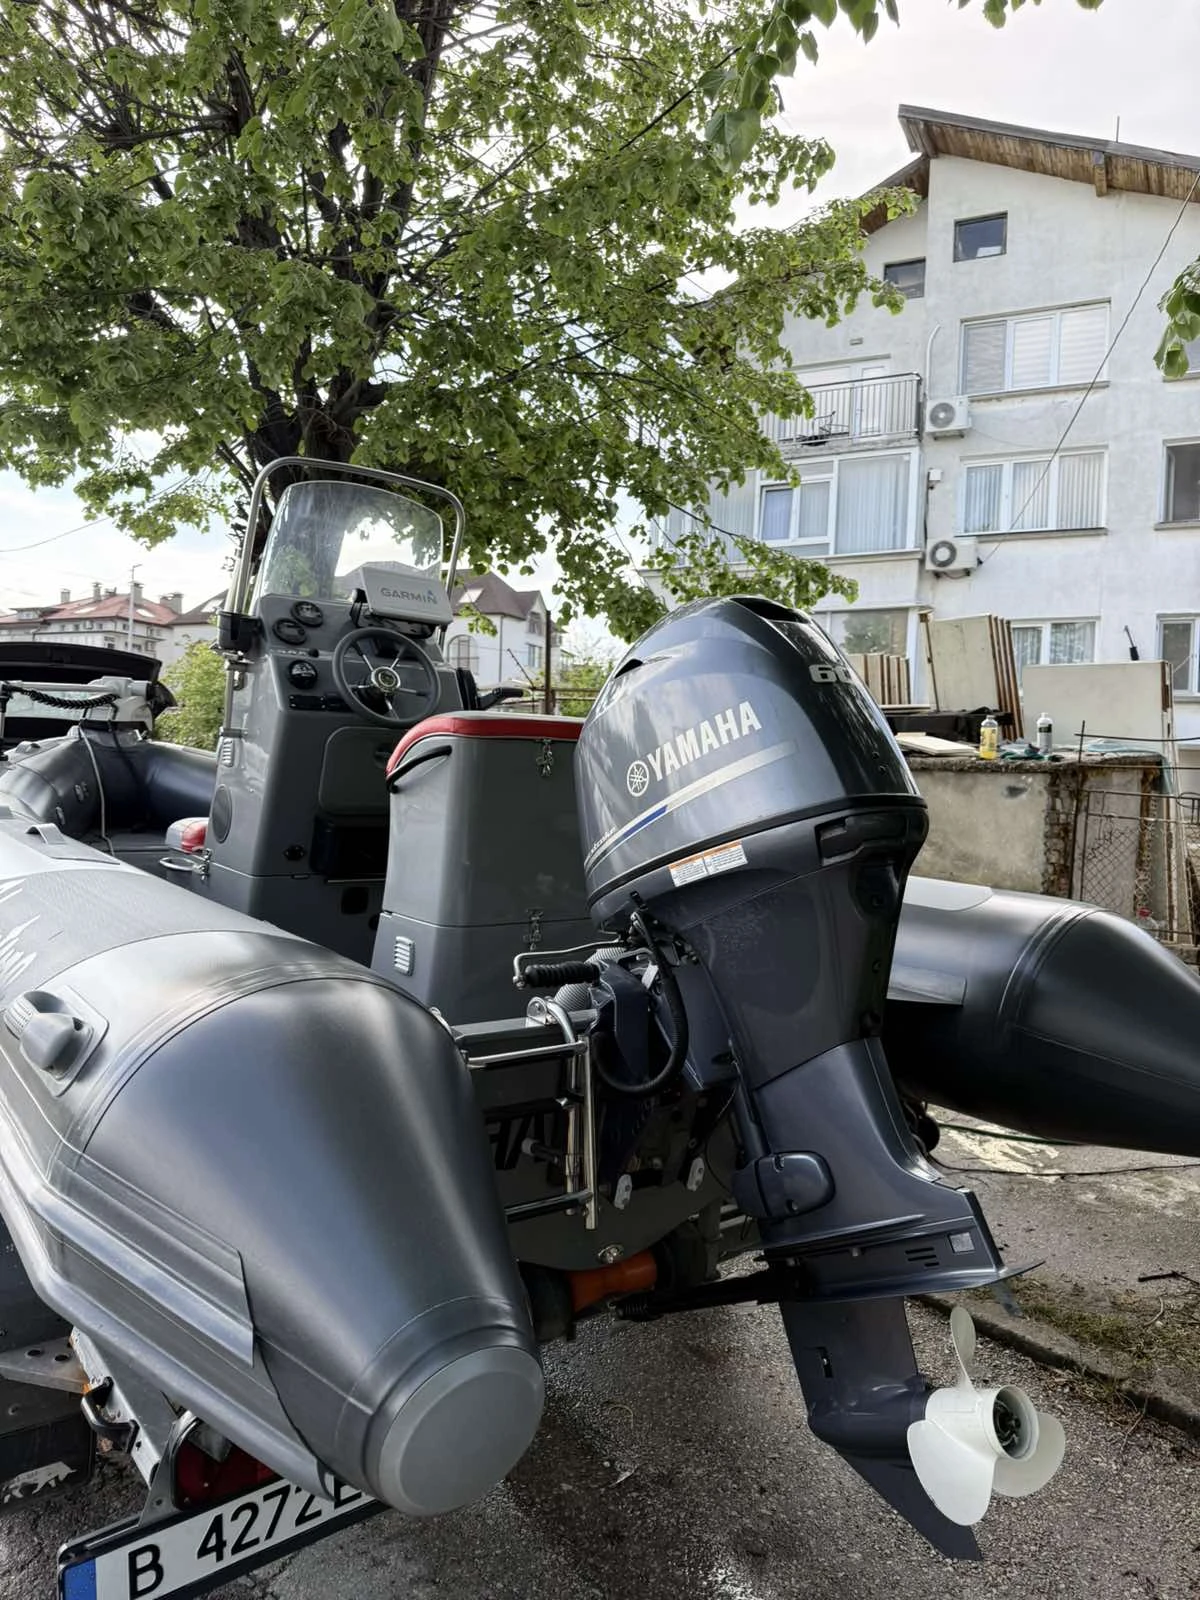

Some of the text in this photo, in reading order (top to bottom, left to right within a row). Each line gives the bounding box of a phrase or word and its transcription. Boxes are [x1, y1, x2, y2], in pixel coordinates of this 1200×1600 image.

[380, 587, 438, 605] GARMIN
[647, 701, 763, 782] YAMAHA
[128, 1544, 164, 1600] B
